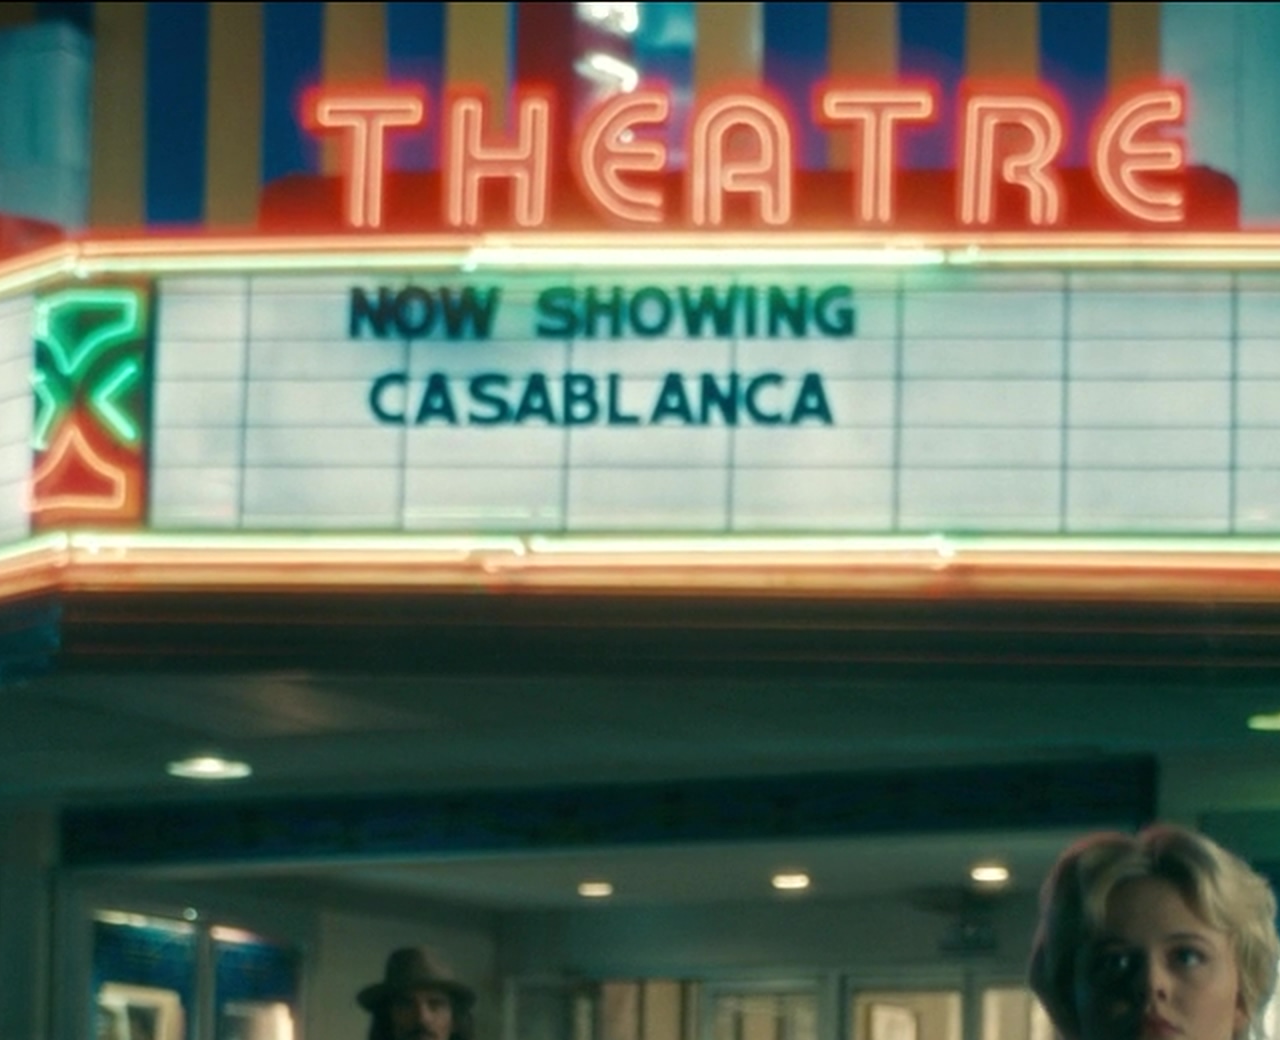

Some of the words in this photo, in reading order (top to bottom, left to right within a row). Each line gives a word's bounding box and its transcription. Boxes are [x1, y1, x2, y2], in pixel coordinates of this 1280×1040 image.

[312, 87, 1188, 228] THEATRE
[347, 285, 500, 340] NOW
[535, 284, 856, 340] SHOWING
[370, 371, 837, 427] CASABLANCA
